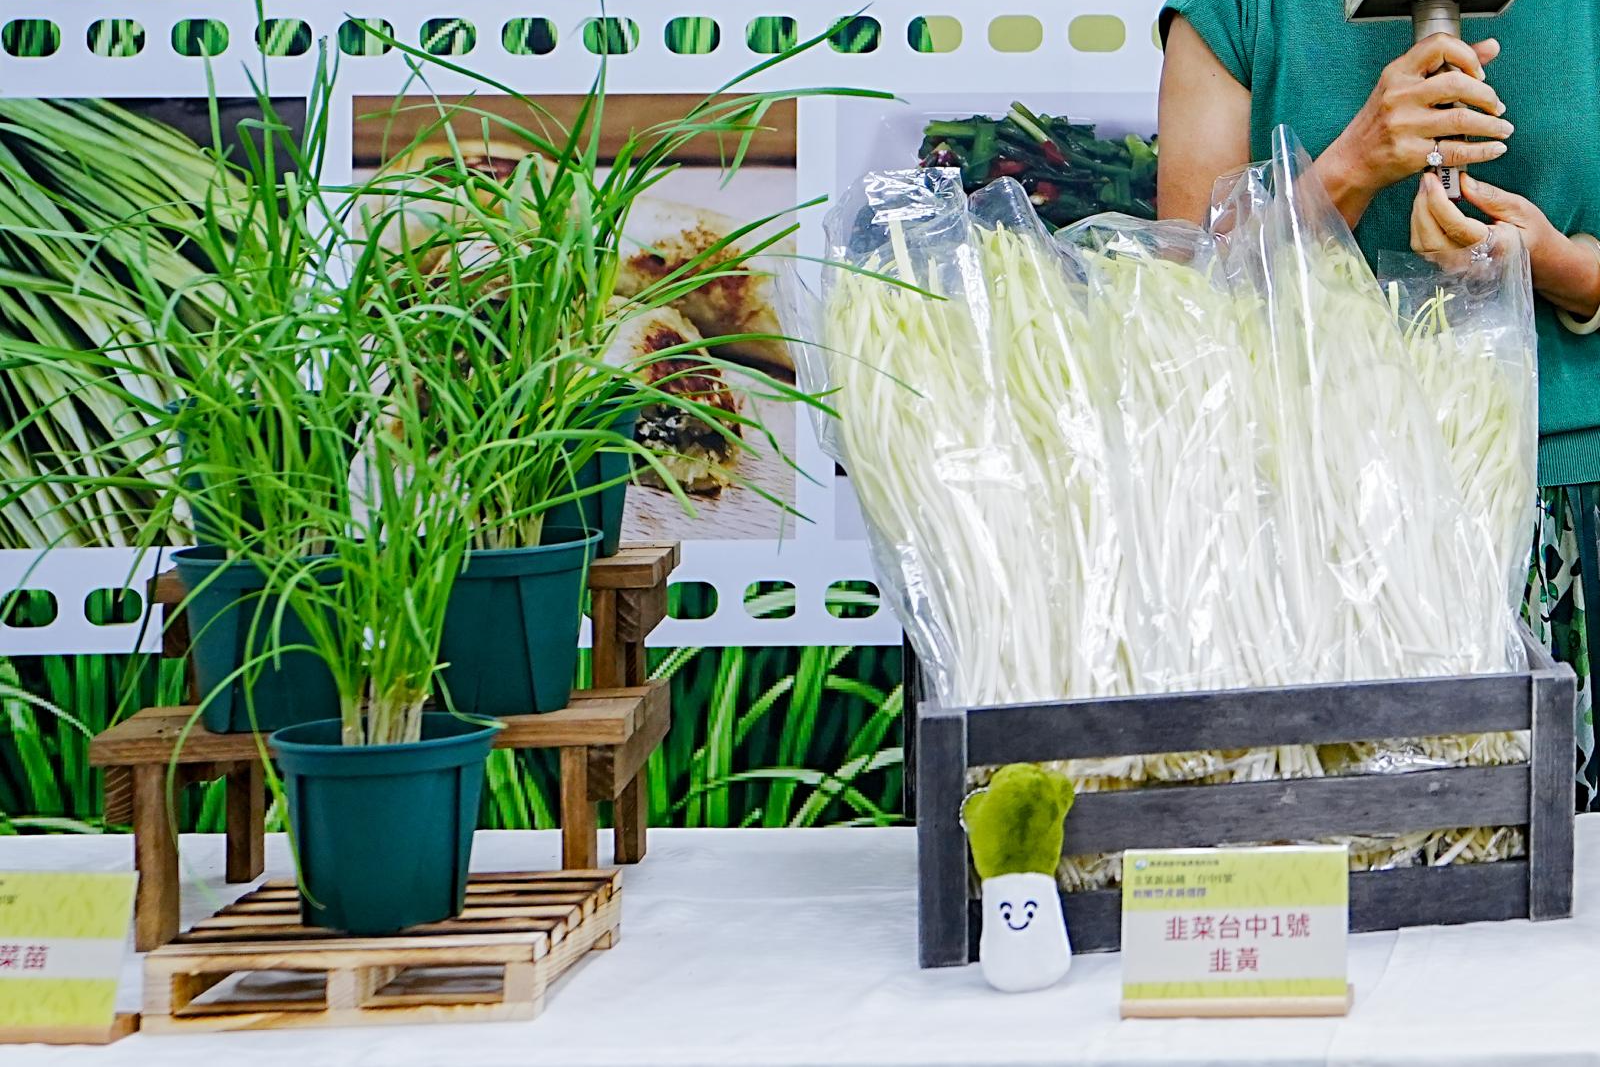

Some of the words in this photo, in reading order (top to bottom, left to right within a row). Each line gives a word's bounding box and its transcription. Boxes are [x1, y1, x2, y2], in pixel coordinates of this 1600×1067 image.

[1164, 912, 1312, 942] 韭菜台中1號
[1208, 946, 1261, 974] 韭黃
